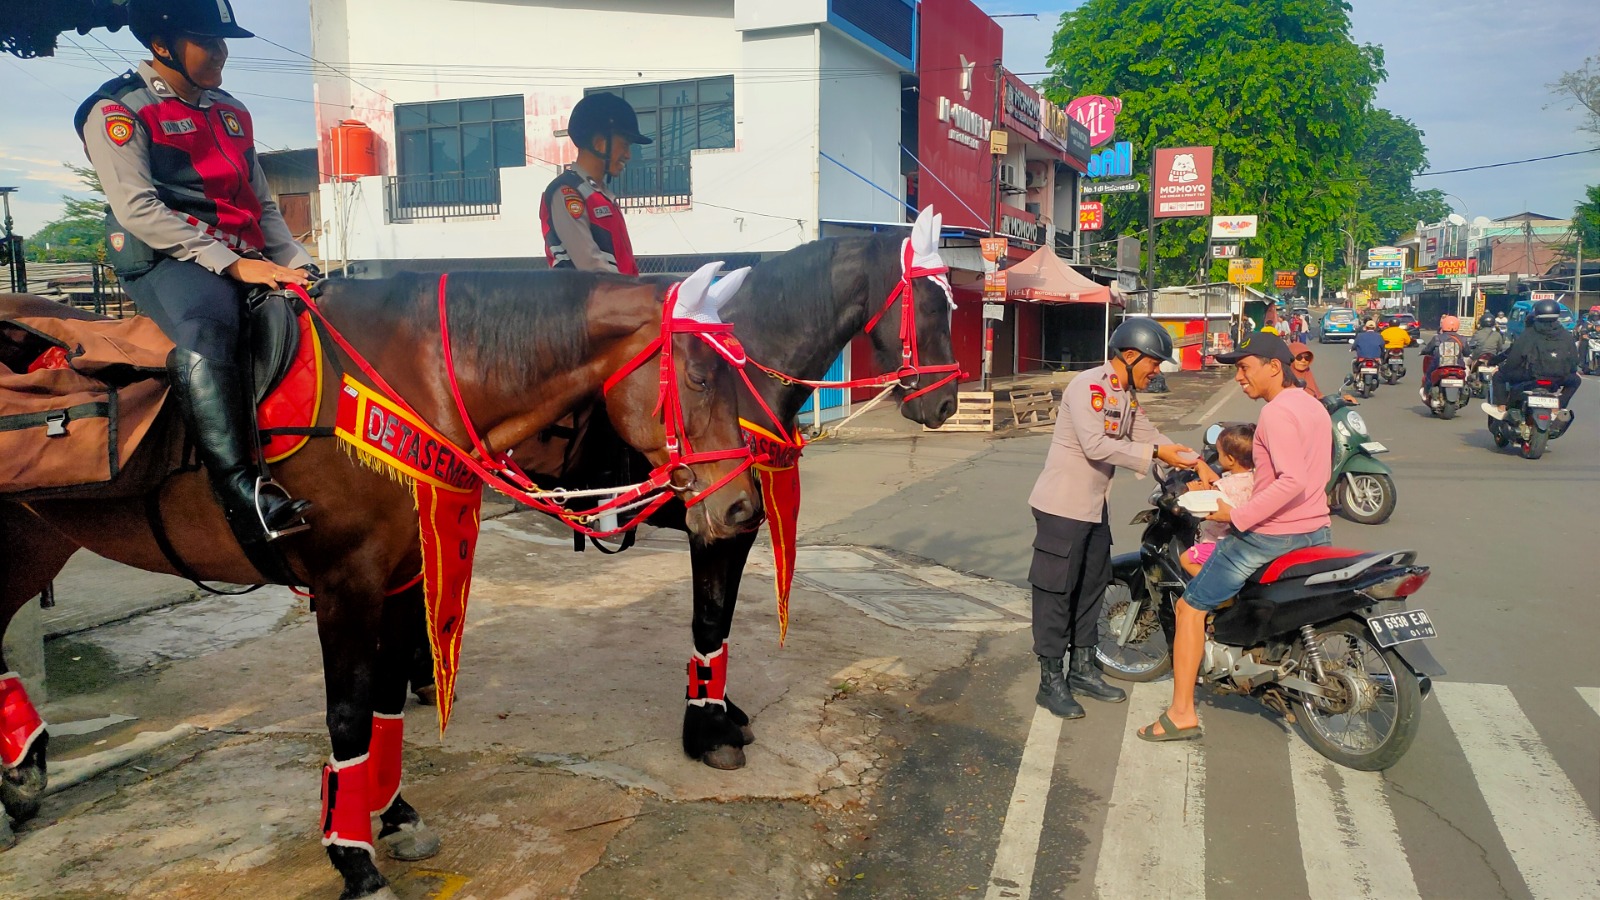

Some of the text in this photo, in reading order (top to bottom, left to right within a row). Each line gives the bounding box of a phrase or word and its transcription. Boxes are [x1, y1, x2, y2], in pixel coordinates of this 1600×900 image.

[1105, 184, 1134, 192] Indonesia
[1080, 211, 1095, 221] 24
[1438, 260, 1466, 268] BAKM
[1371, 620, 1383, 634] B
